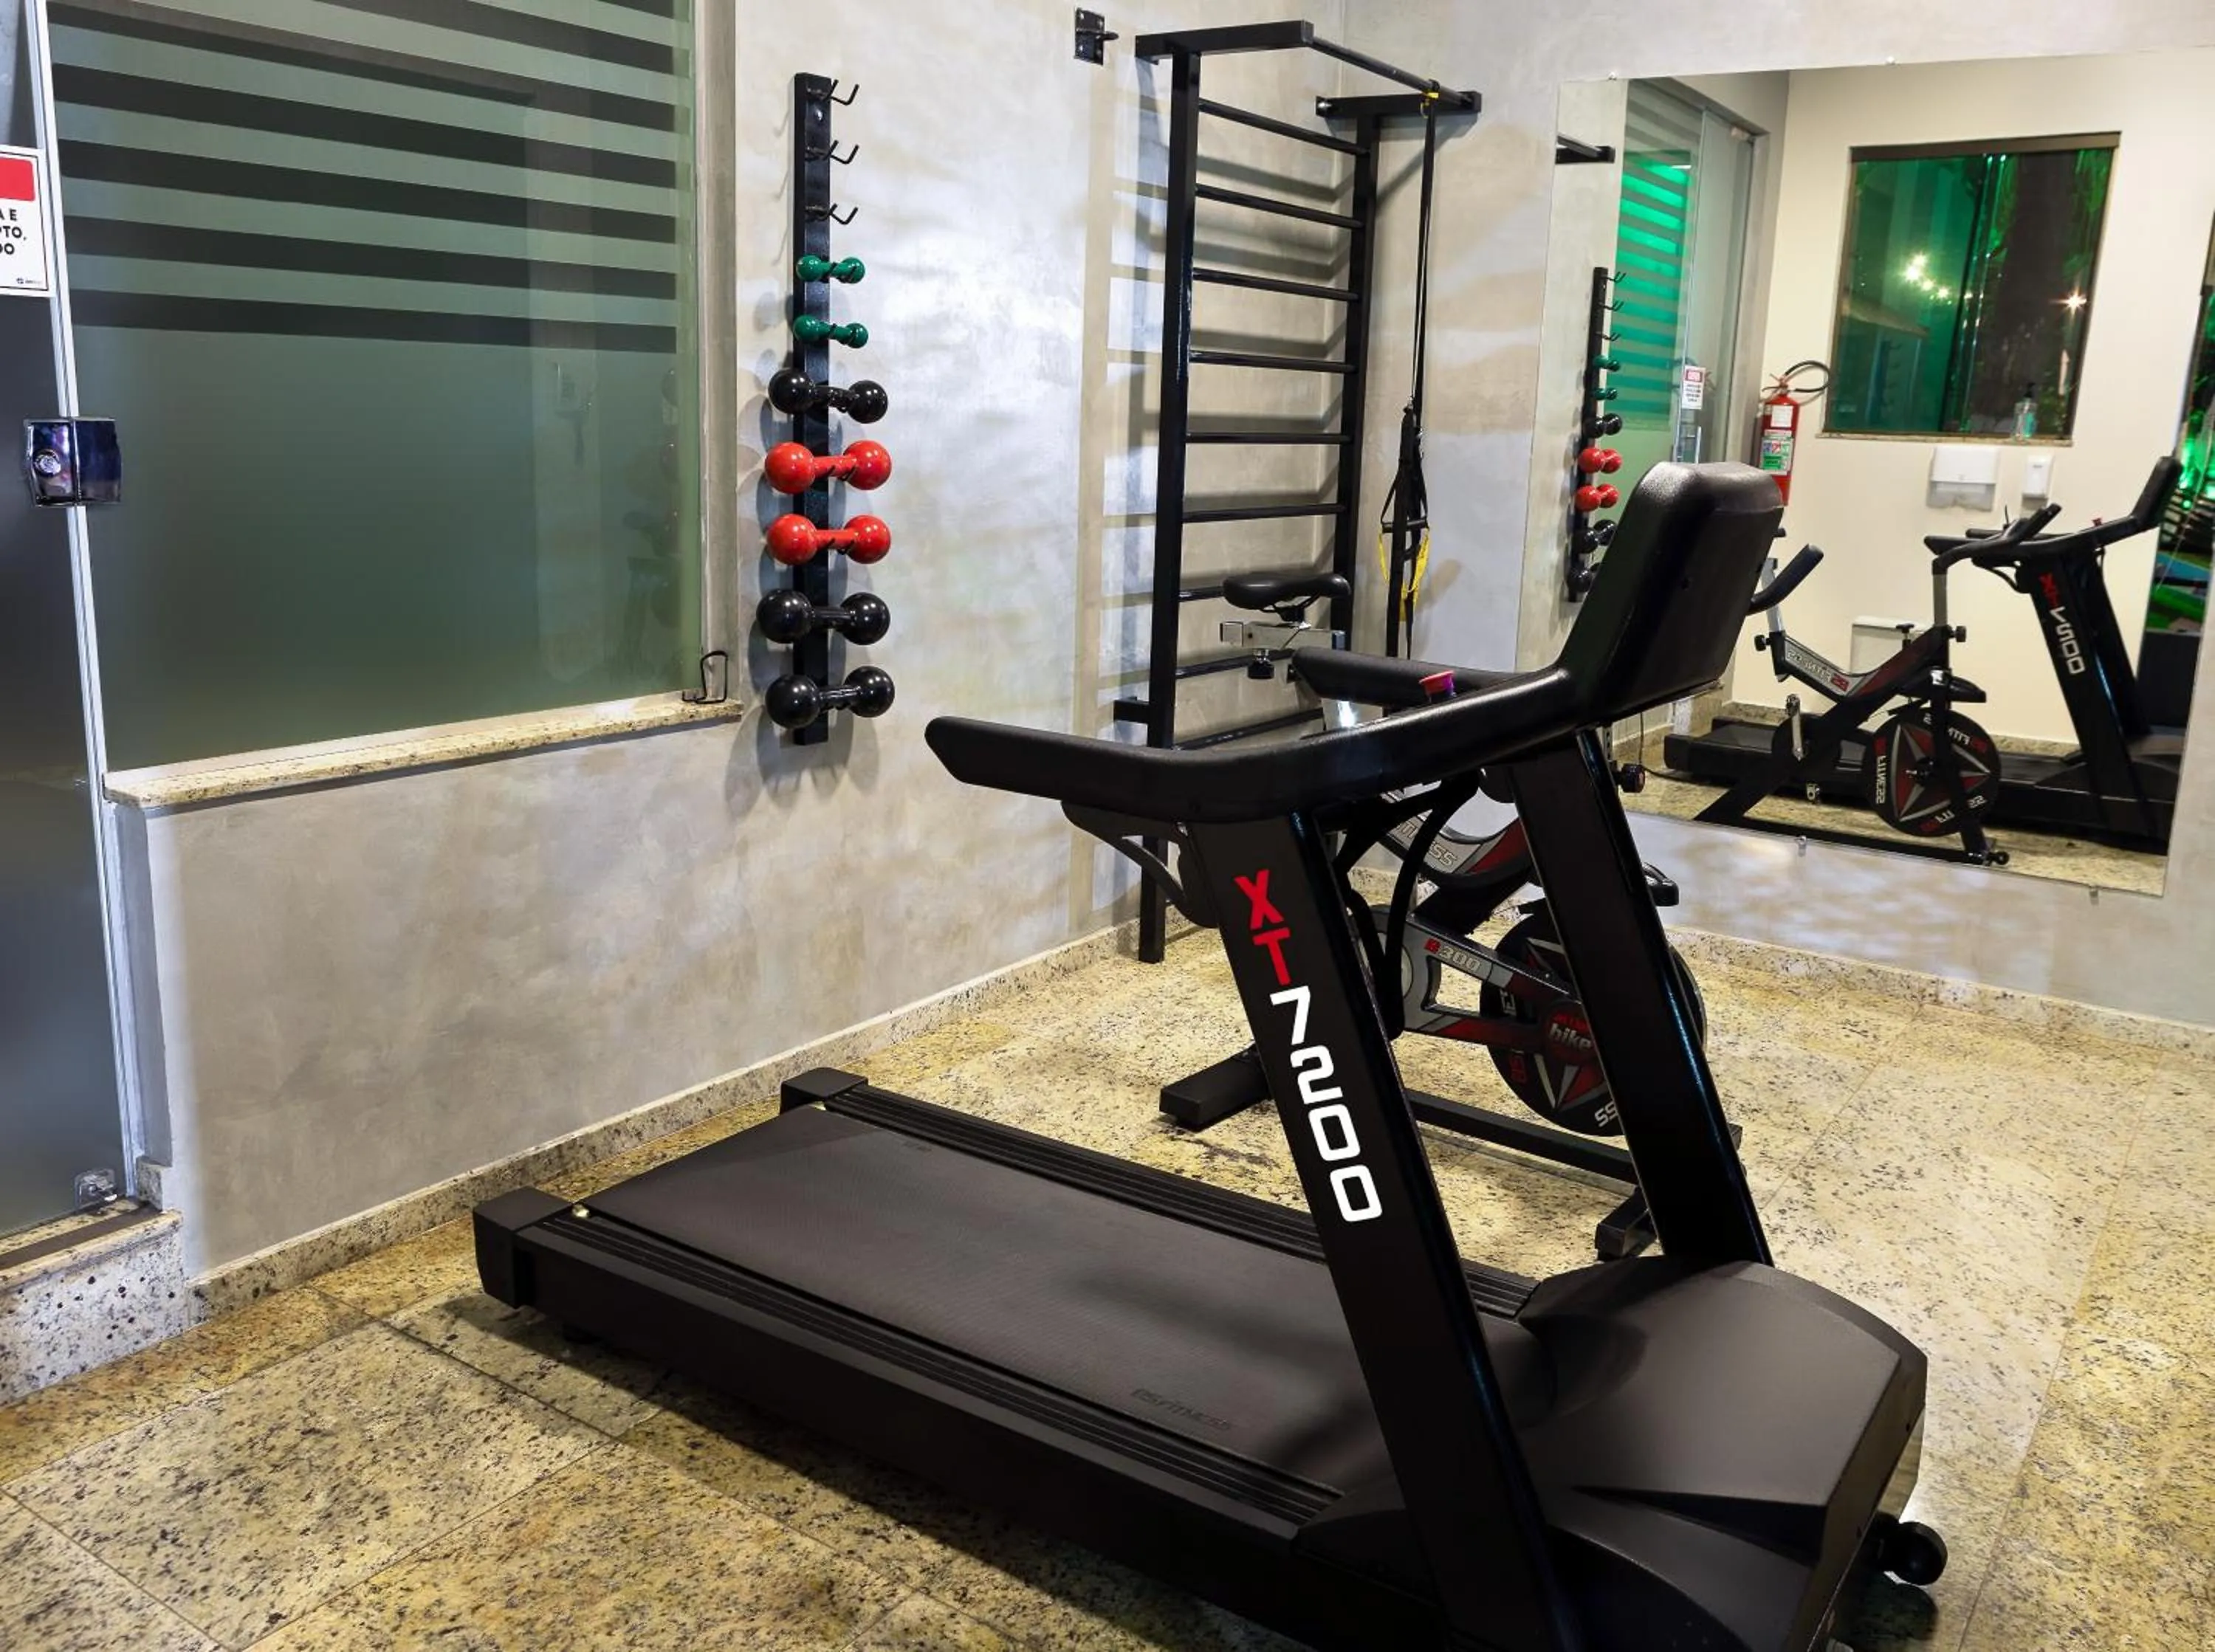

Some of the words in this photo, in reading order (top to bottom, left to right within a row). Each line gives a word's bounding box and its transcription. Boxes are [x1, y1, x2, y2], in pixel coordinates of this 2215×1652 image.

[10, 209, 17, 221] E
[0, 225, 27, 241] TO,
[1234, 869, 1383, 1222] XT7200
